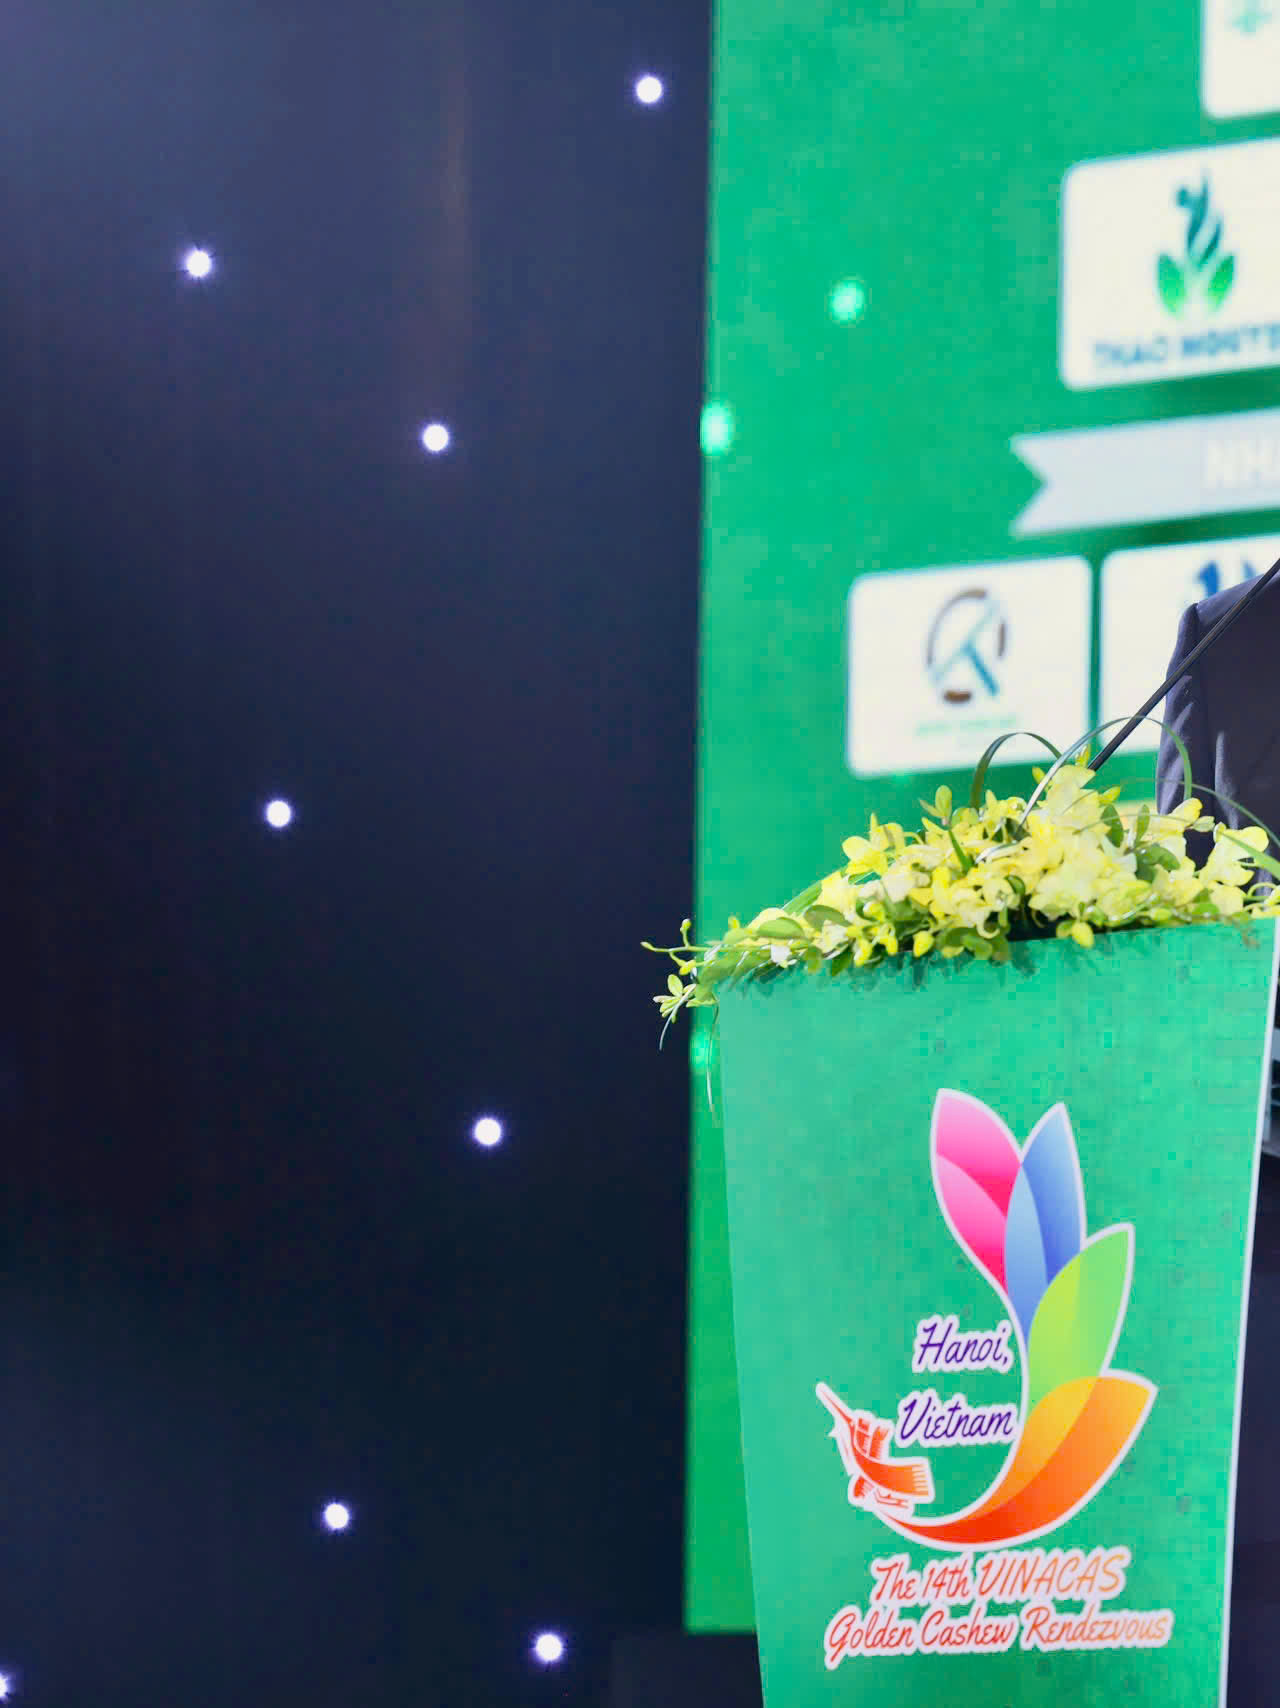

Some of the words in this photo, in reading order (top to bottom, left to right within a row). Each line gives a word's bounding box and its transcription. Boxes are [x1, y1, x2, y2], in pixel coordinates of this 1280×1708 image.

[917, 1321, 1010, 1366] Hanoi,
[899, 1396, 1013, 1440] Vietnam
[875, 1561, 916, 1600] The
[922, 1560, 970, 1597] 14th
[978, 1554, 1124, 1595] VINACAS
[829, 1610, 914, 1662] Golden
[921, 1606, 1016, 1646] Cashew
[1025, 1606, 1168, 1644] Rendezvous
